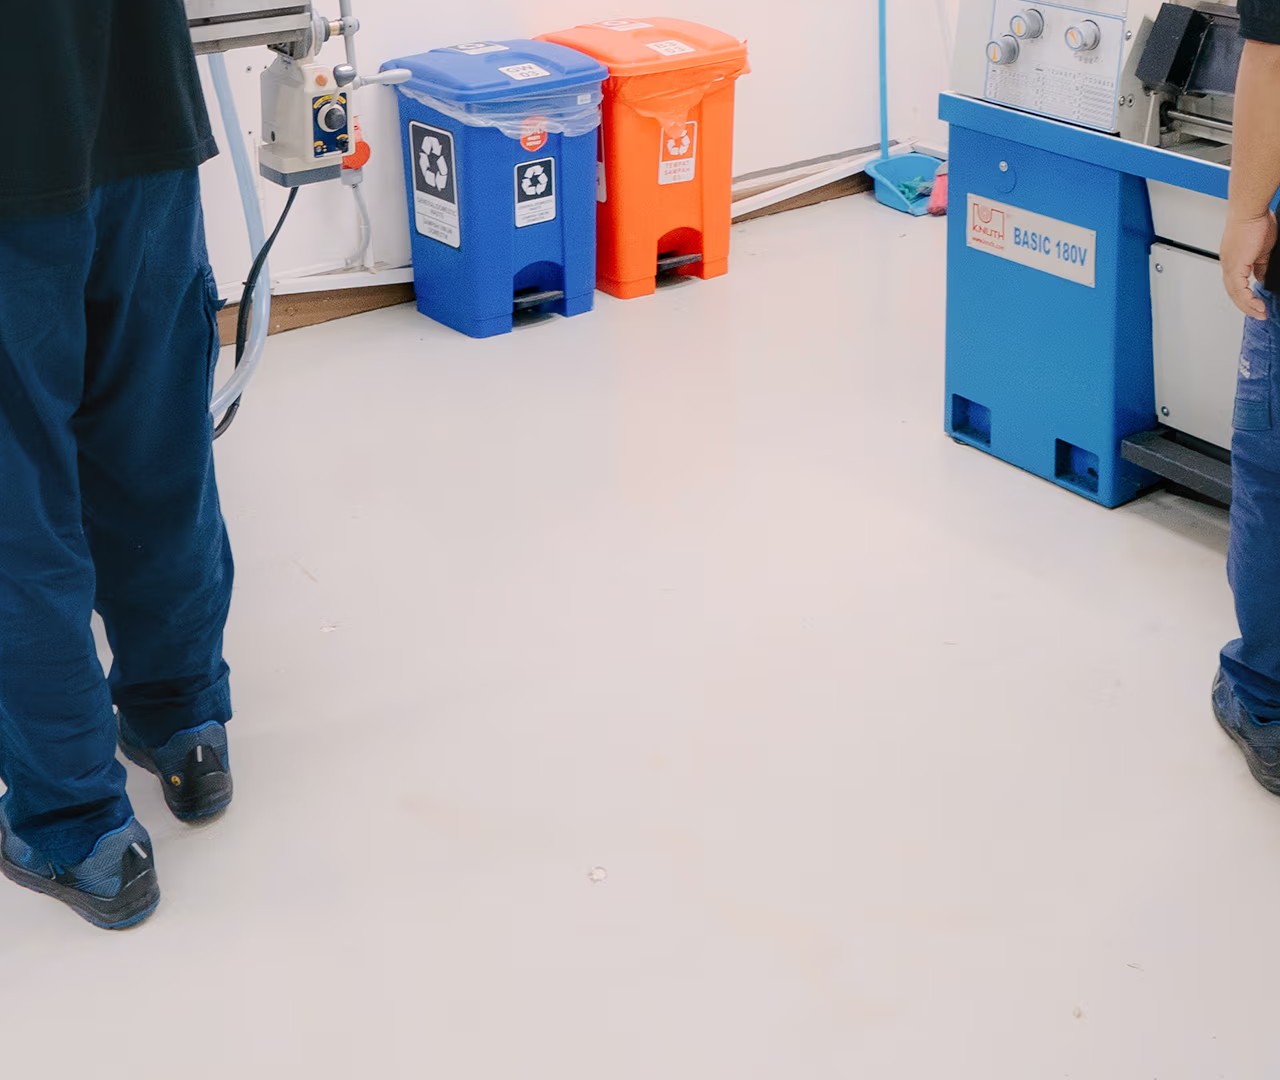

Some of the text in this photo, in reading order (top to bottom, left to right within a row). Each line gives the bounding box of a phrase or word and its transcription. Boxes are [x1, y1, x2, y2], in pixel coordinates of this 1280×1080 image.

[972, 224, 1005, 240] KNUTH
[1013, 226, 1088, 267] BASIC 180V
